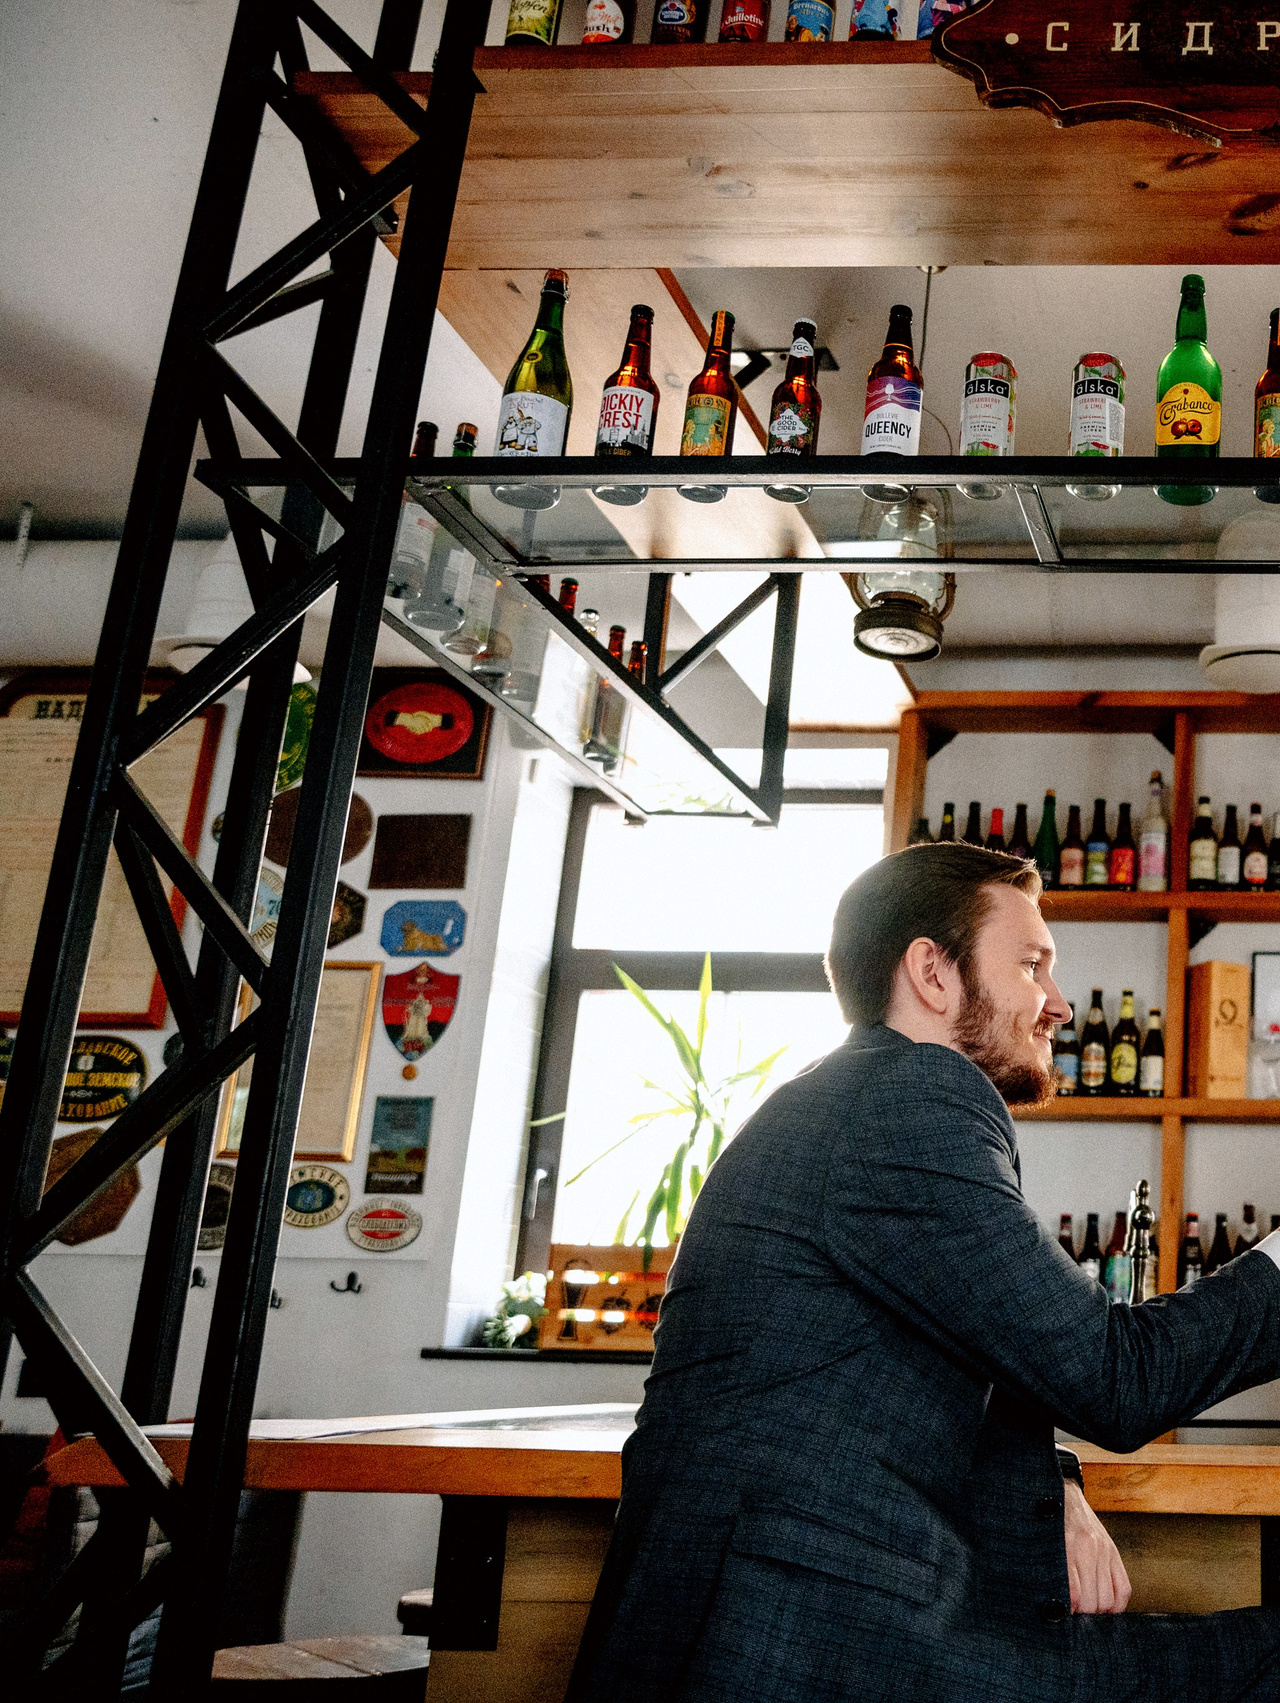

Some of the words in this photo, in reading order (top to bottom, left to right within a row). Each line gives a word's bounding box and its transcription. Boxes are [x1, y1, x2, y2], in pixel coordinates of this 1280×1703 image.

[967, 380, 1004, 394] älska
[1077, 379, 1114, 395] älska
[1159, 397, 1212, 426] Trabanco
[865, 421, 911, 438] QUEENCY
